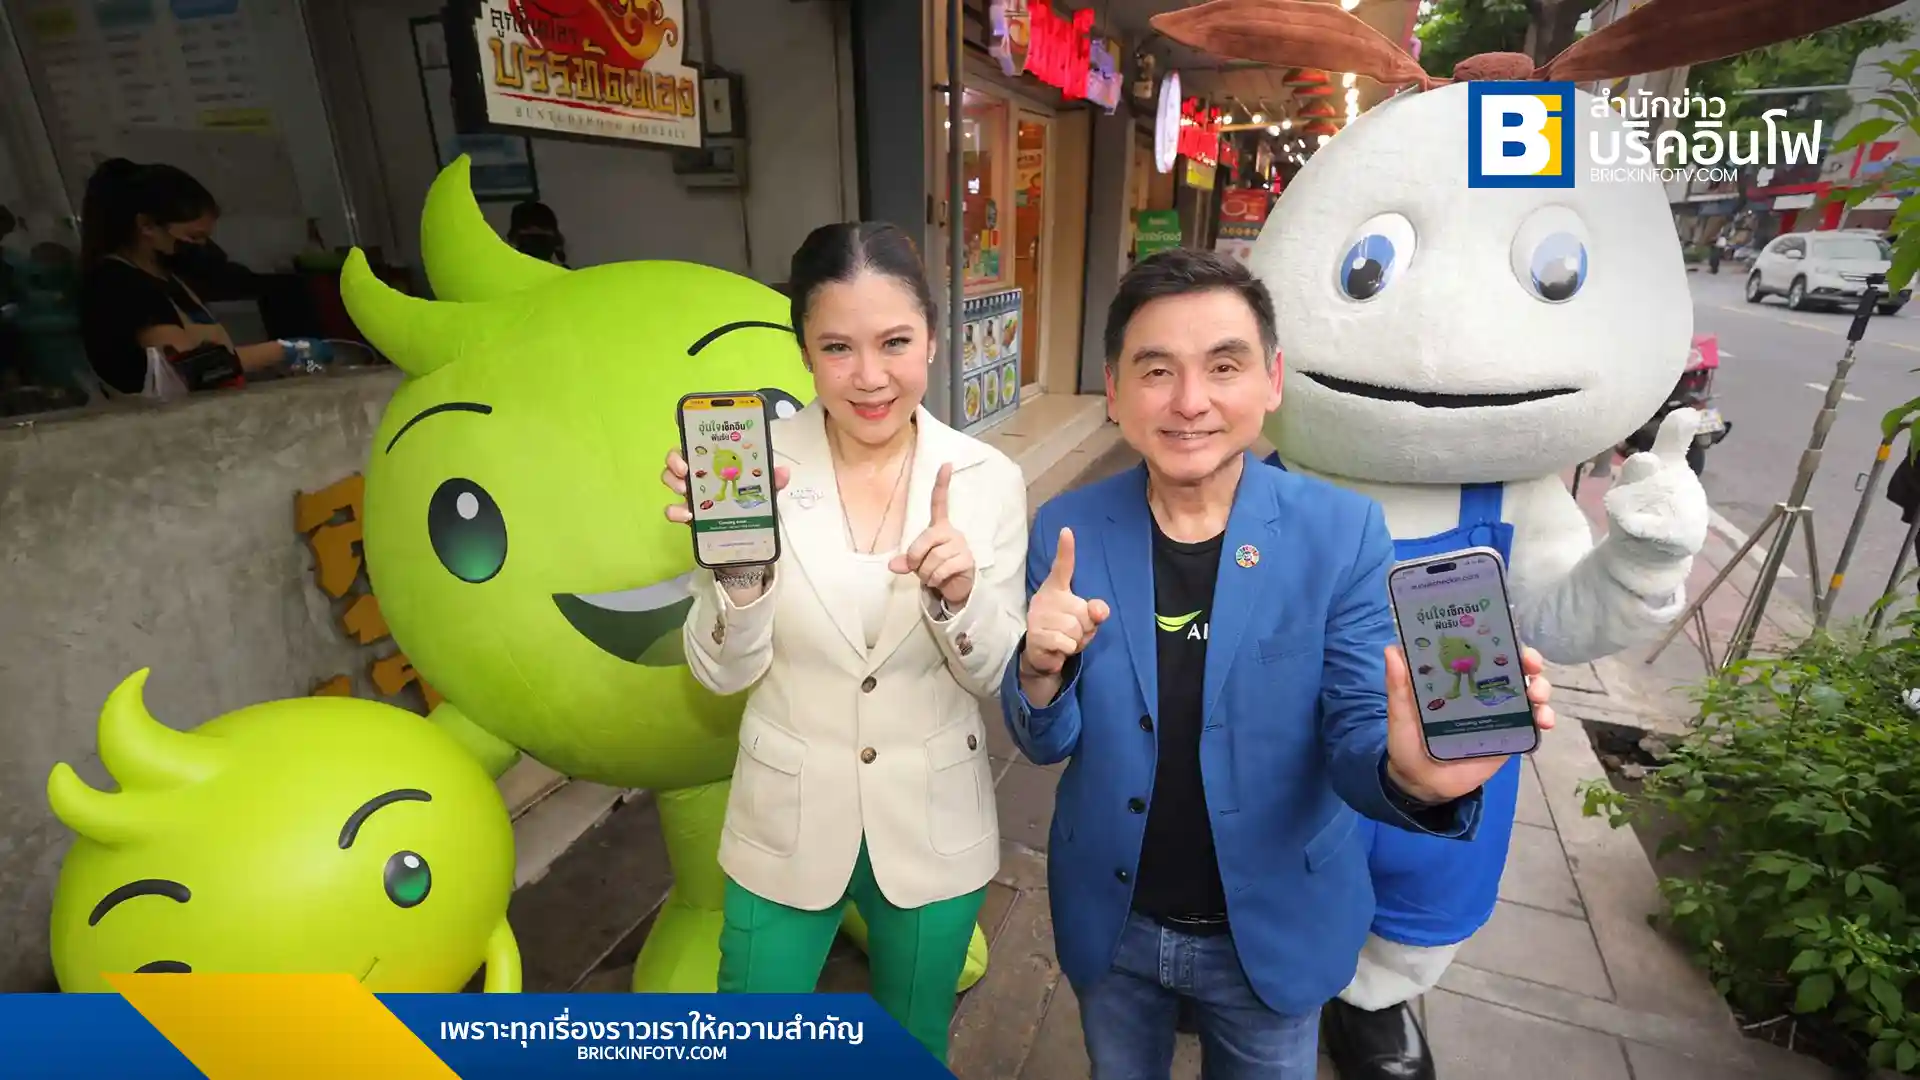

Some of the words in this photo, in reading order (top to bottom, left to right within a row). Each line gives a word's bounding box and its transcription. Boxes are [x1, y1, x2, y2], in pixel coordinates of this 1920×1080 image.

[489, 37, 696, 118] บรรทัดทอง
[1135, 230, 1182, 242] GrabFood
